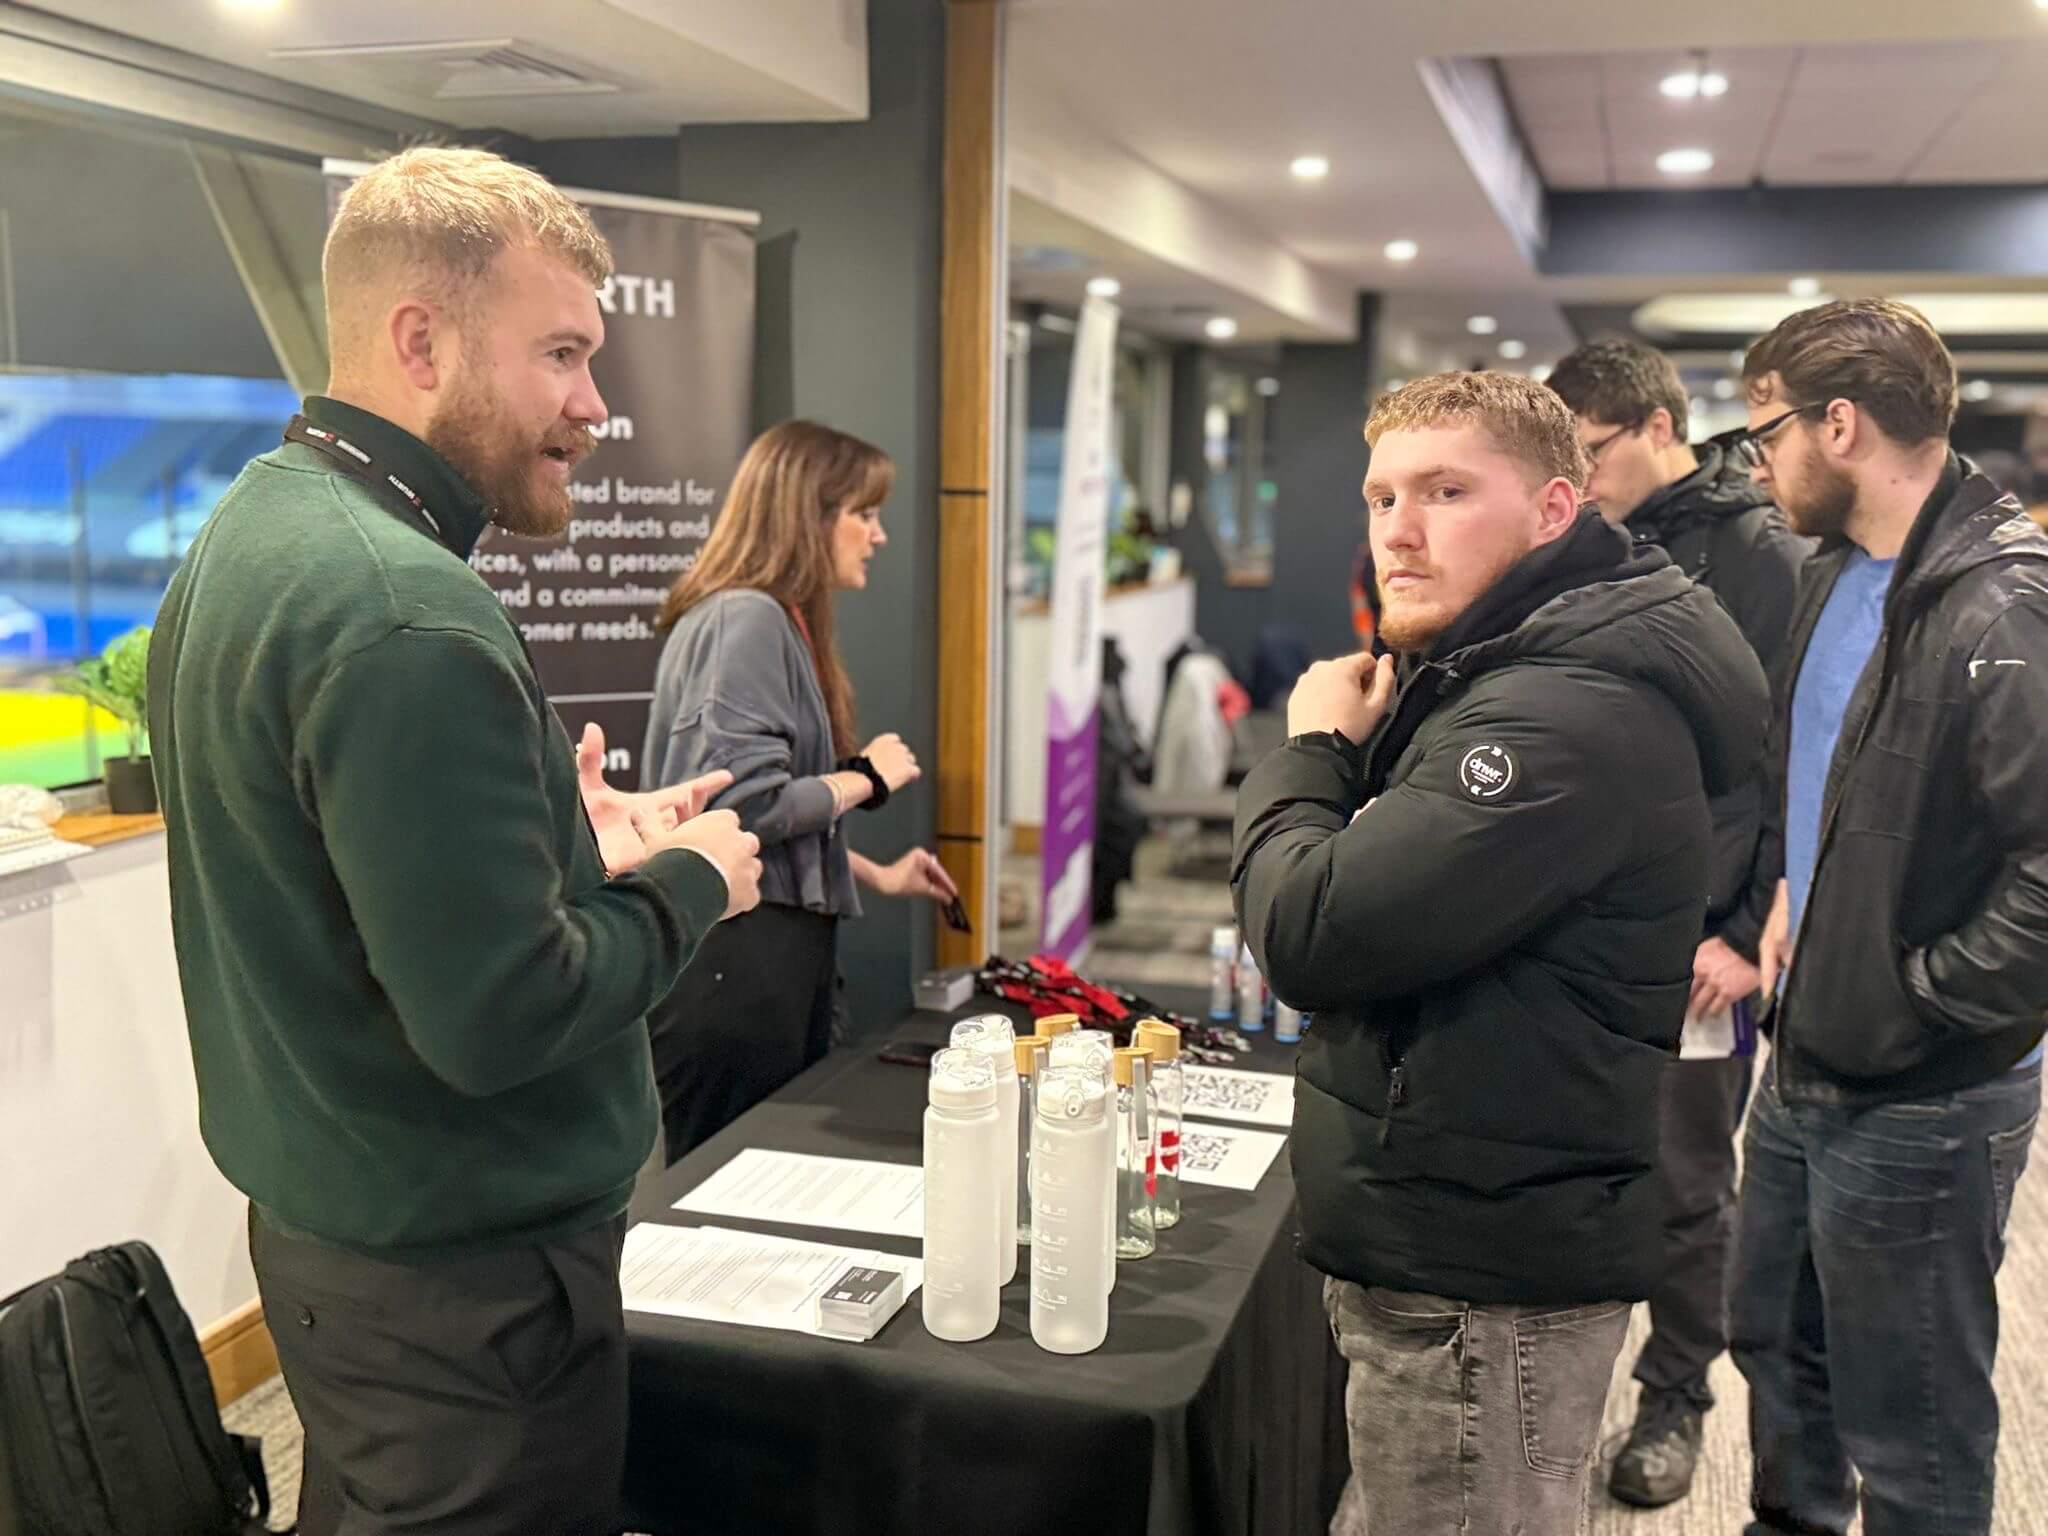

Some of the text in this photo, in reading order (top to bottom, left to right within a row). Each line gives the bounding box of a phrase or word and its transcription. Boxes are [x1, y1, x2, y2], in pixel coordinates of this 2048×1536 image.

[615, 477, 681, 505] brand
[686, 478, 715, 505] for
[569, 511, 710, 544] products and
[532, 546, 581, 572] with
[586, 553, 603, 573] a
[494, 580, 531, 608] nd
[536, 588, 554, 608] a
[581, 613, 655, 641] needs.
